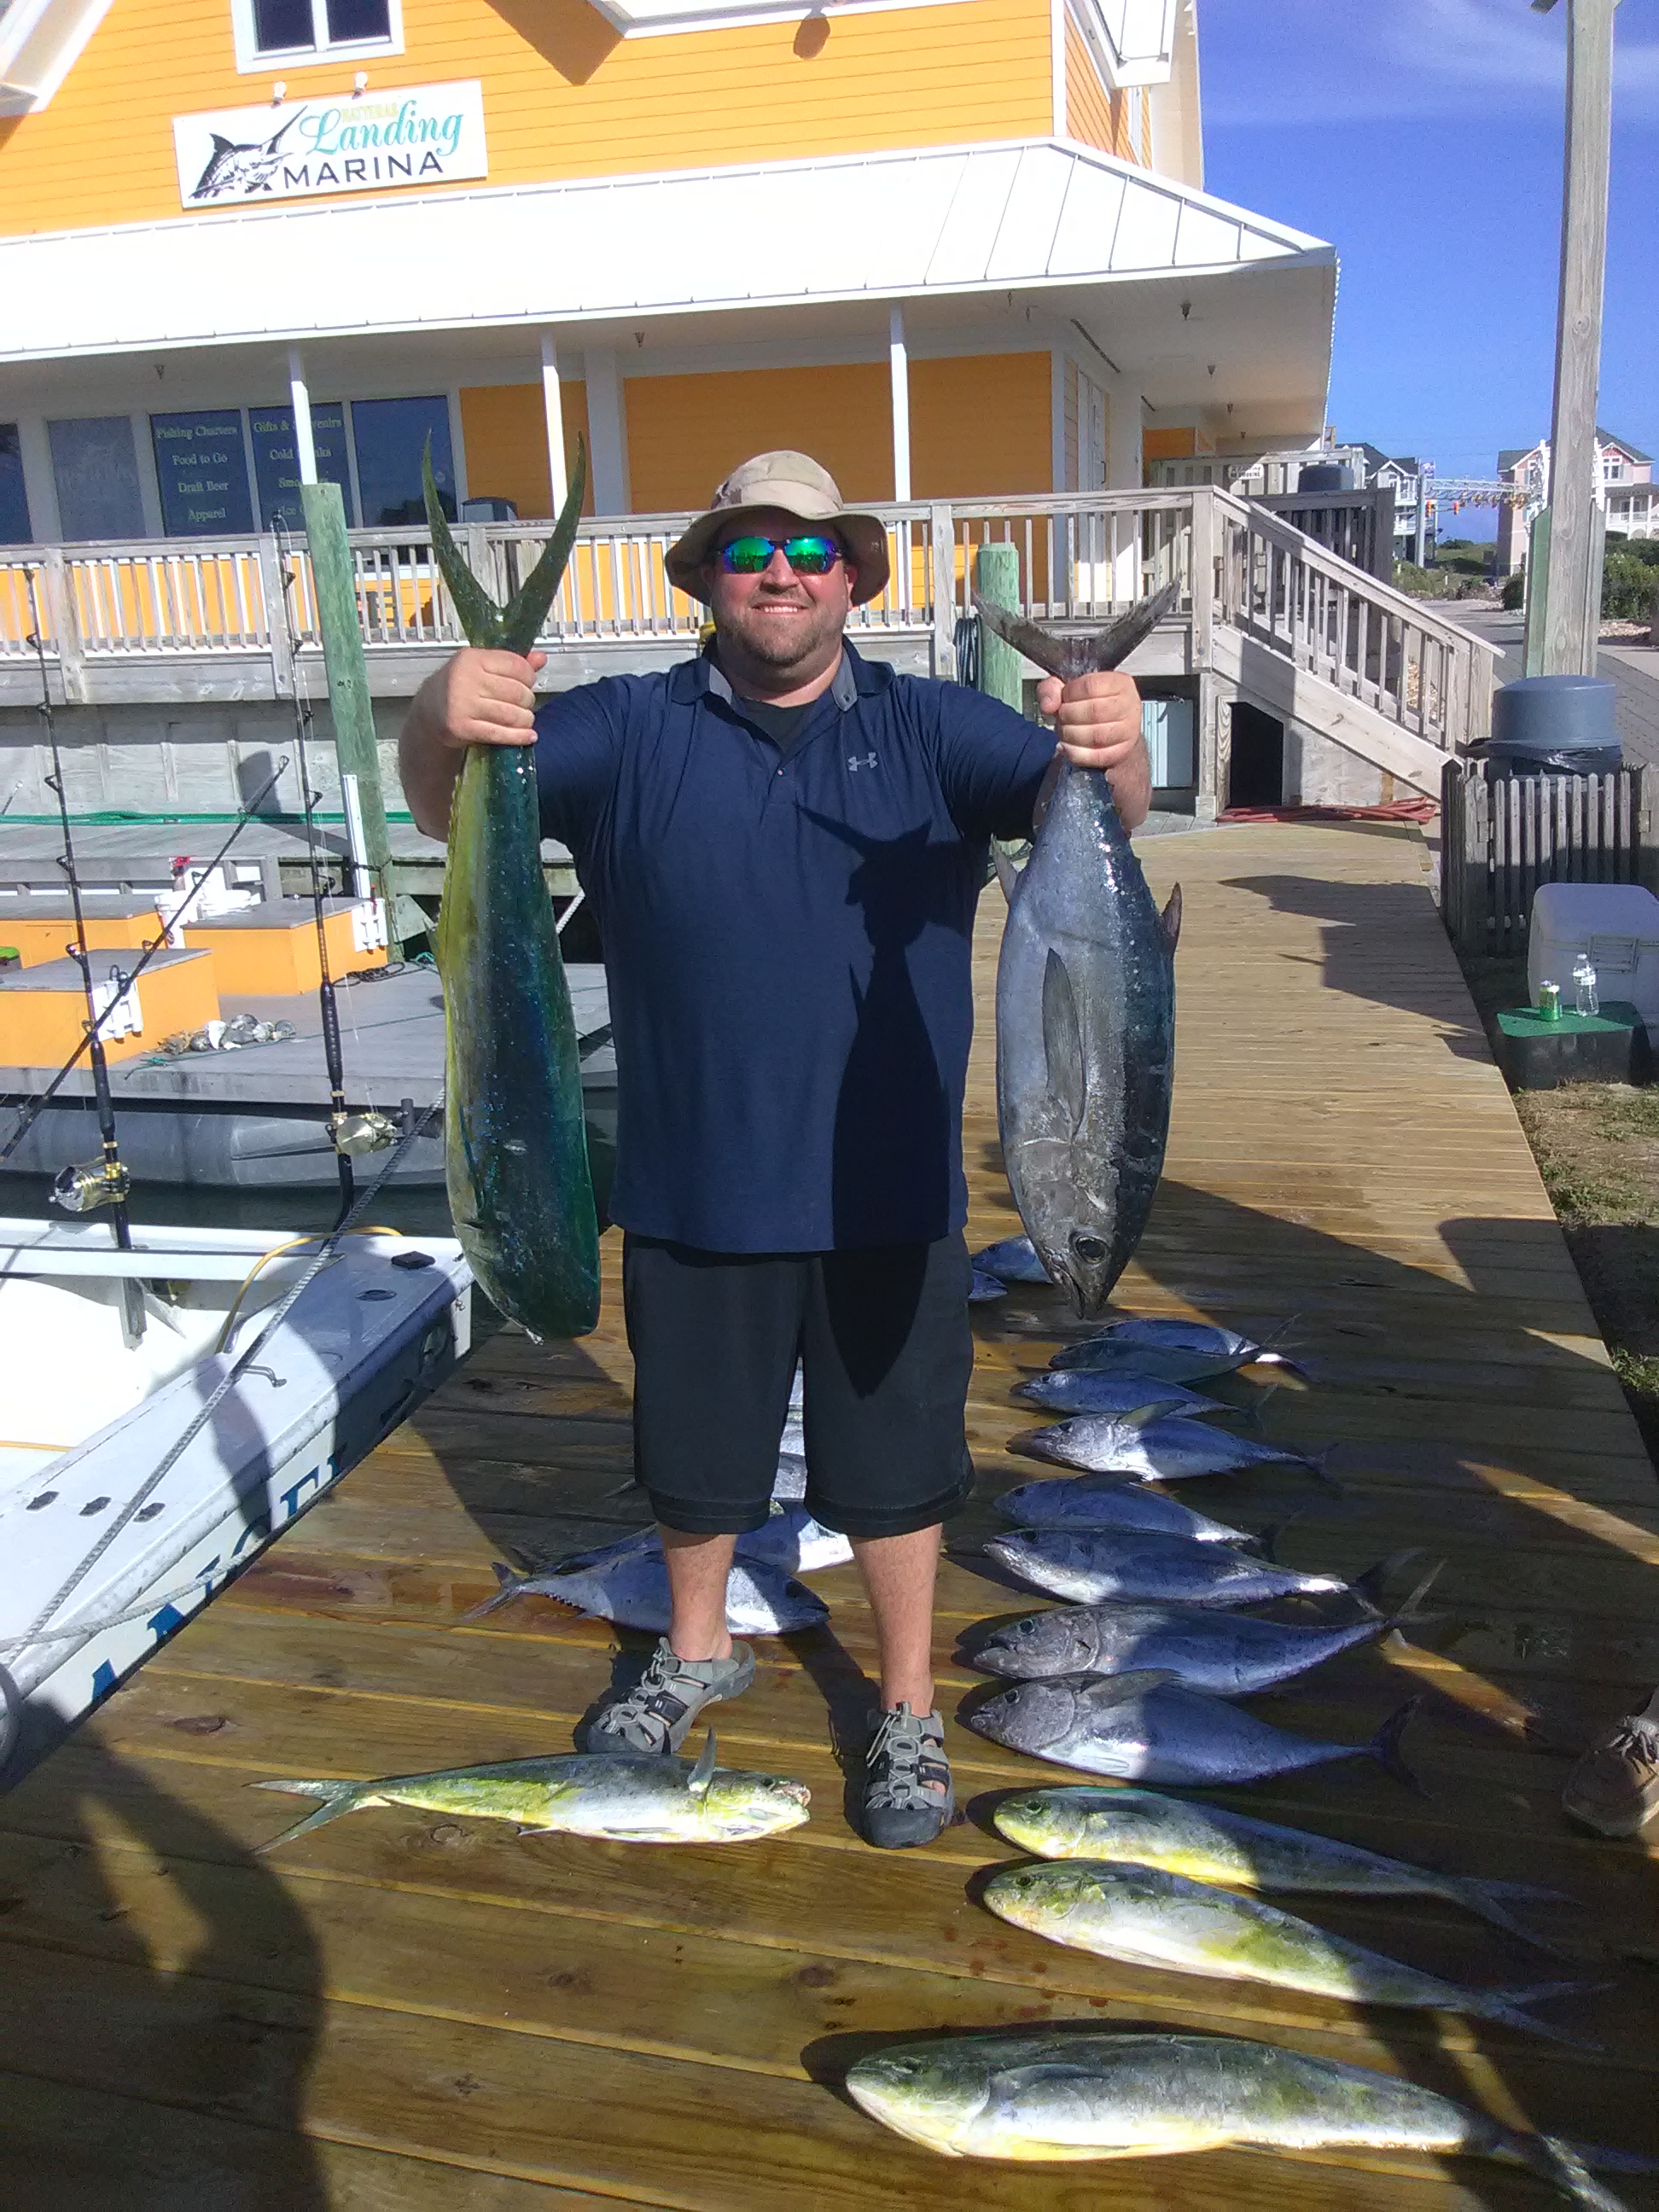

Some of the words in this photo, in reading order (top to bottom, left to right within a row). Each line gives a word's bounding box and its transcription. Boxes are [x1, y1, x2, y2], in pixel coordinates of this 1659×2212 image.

[300, 100, 463, 157] Landing
[284, 151, 444, 189] MARINA
[157, 428, 193, 439] Fishing
[195, 426, 237, 436] Charters
[254, 421, 278, 432] Gifts
[281, 420, 289, 431] &
[172, 453, 197, 465] Food
[200, 454, 211, 464] to
[212, 452, 228, 463] Go
[270, 449, 294, 460] Cold
[178, 481, 204, 492] Draft
[207, 480, 228, 491] Beer
[189, 508, 226, 521] Apparel
